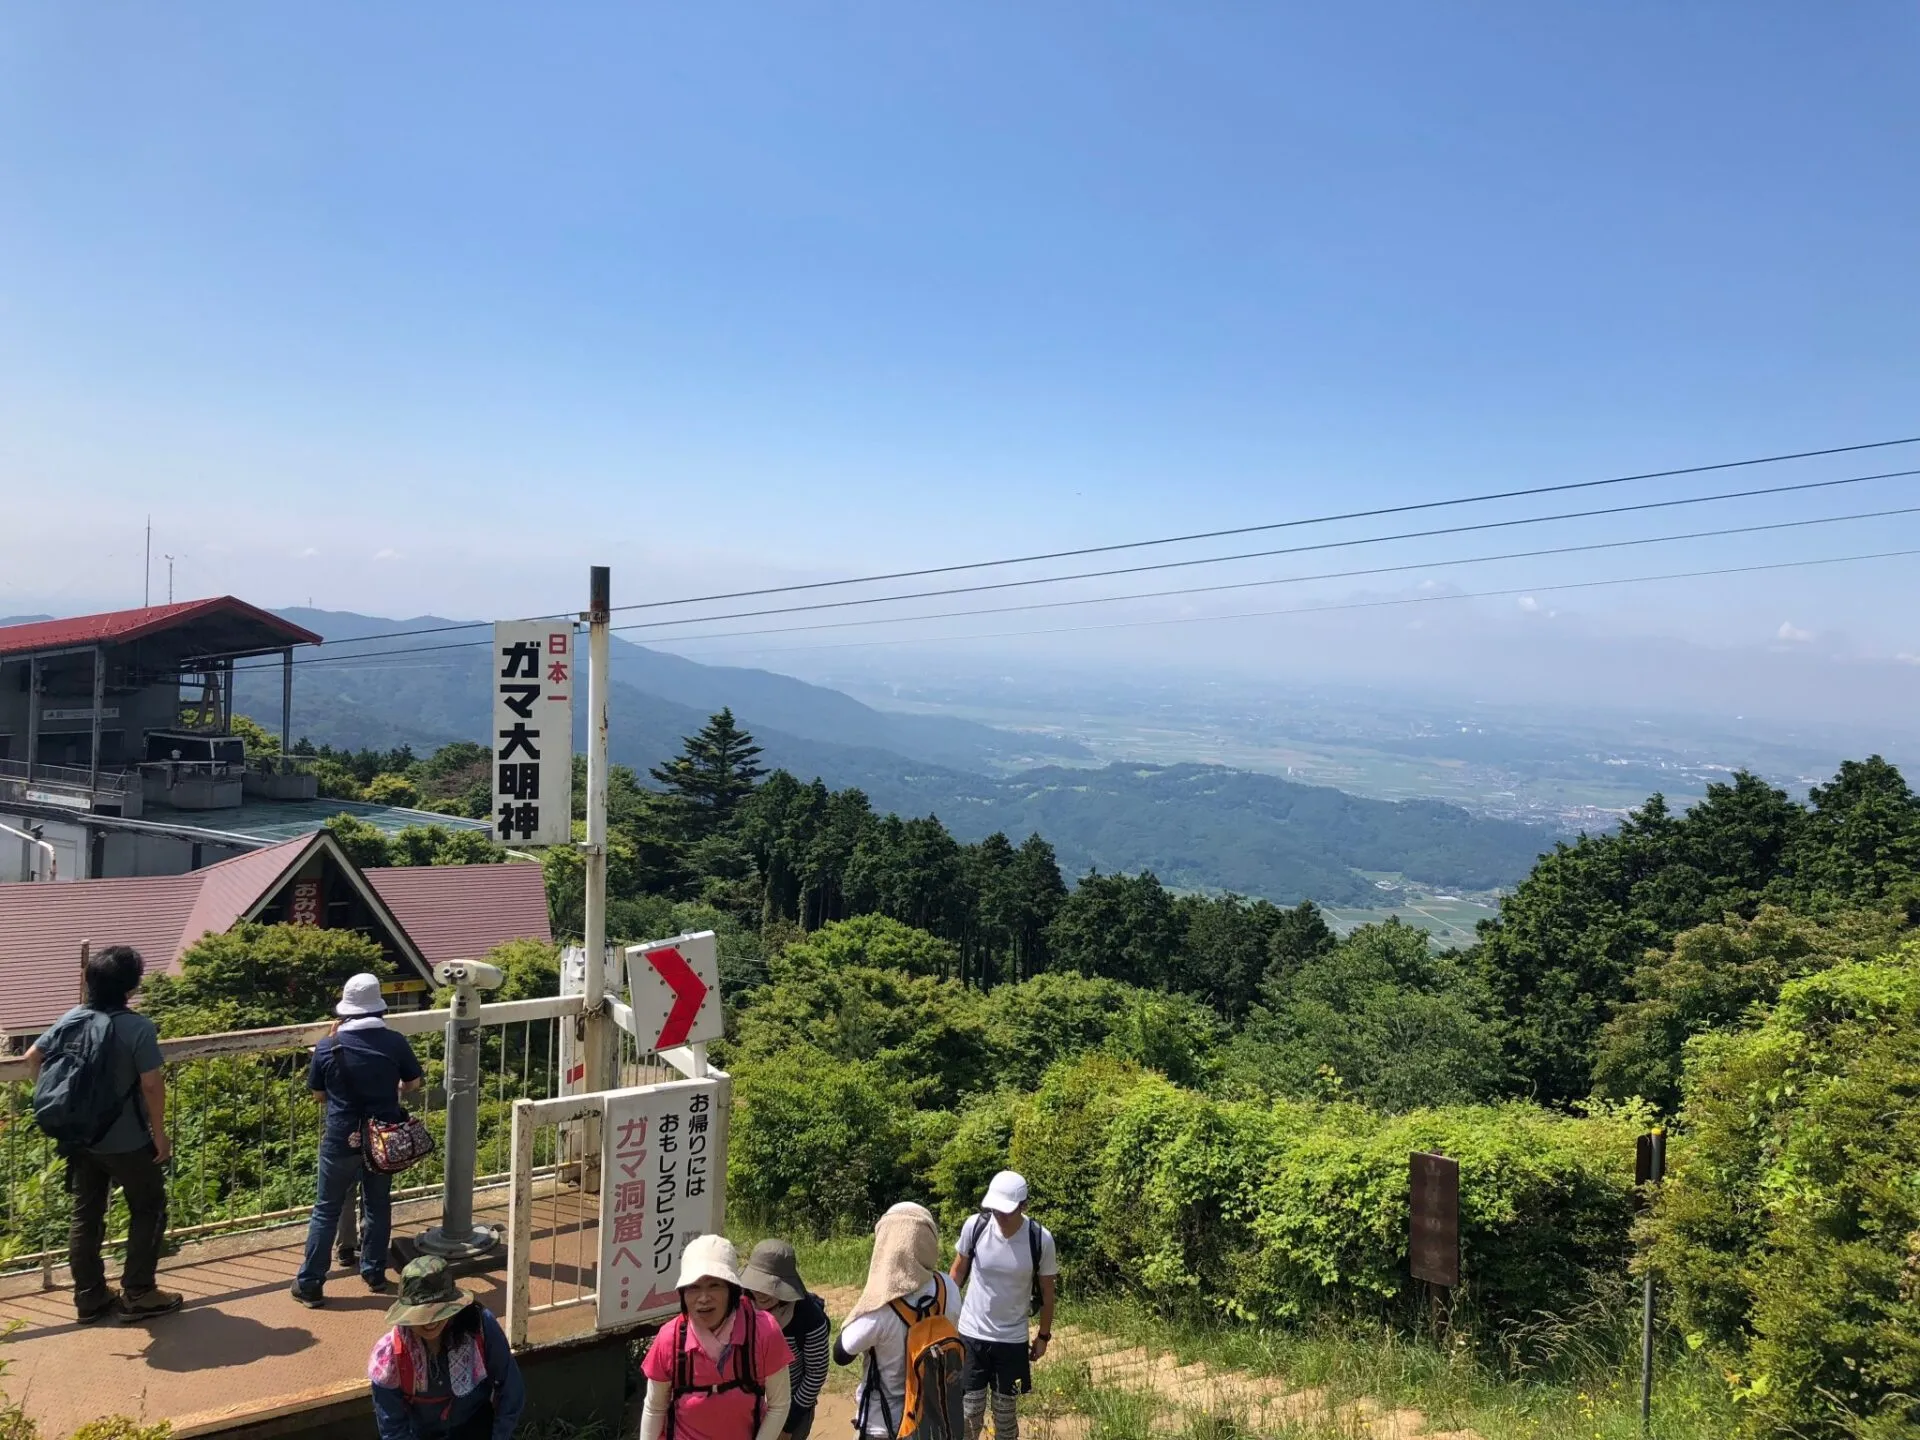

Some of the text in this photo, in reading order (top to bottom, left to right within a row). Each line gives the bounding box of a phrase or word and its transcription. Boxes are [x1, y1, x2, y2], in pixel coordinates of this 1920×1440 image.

[547, 633, 568, 701] 日本一
[498, 640, 541, 841] ガマ大明神
[653, 1113, 680, 1275] おもしろビックリ
[685, 1093, 710, 1198] お帰りには
